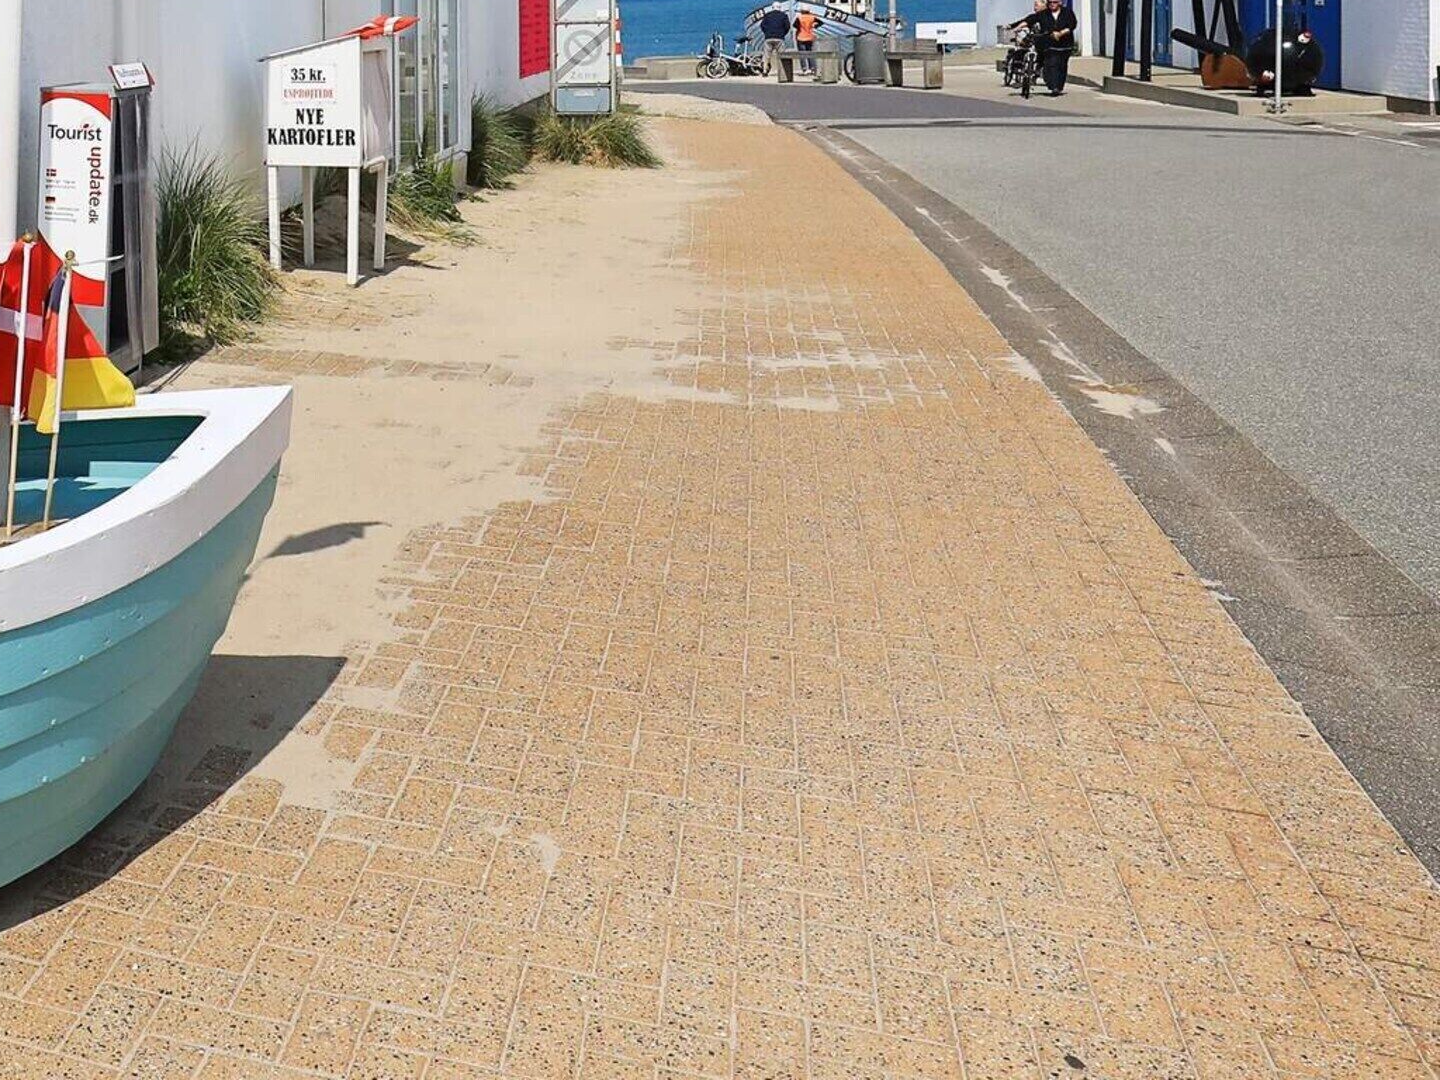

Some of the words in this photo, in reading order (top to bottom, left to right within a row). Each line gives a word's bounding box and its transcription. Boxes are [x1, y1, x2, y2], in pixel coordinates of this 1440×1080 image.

[291, 67, 305, 81] 35
[309, 68, 326, 81] kr.
[296, 108, 324, 125] NYE
[47, 124, 102, 141] Tourist
[267, 128, 356, 146] KARTOFLER
[87, 146, 105, 224] update.dk
